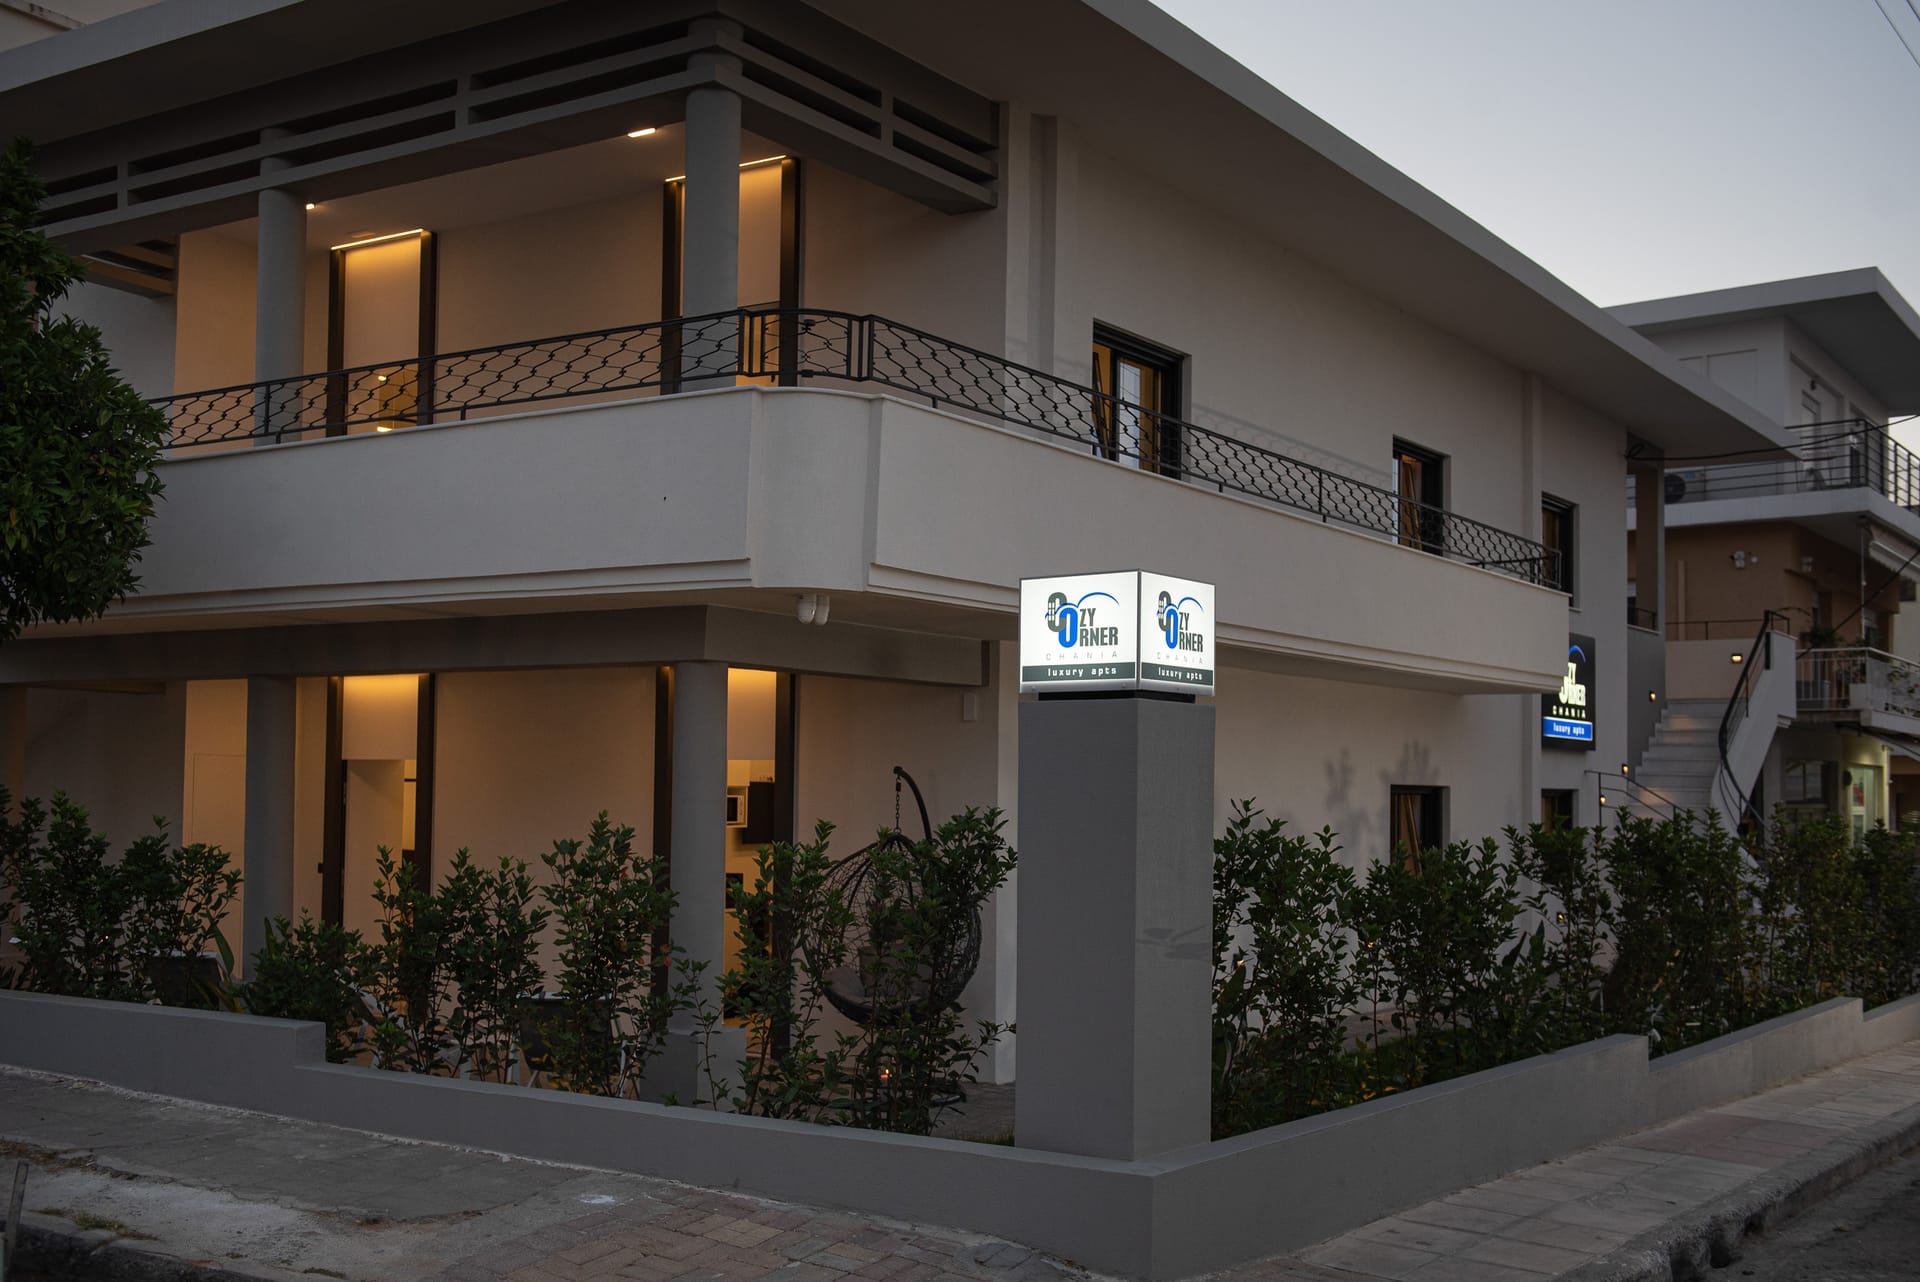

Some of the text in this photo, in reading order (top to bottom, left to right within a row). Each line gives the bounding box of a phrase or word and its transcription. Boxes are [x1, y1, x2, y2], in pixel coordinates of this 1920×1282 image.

[1046, 650, 1118, 661] CHANIA
[1048, 667, 1117, 677] luxury apts
[1158, 667, 1203, 681] luxury apts
